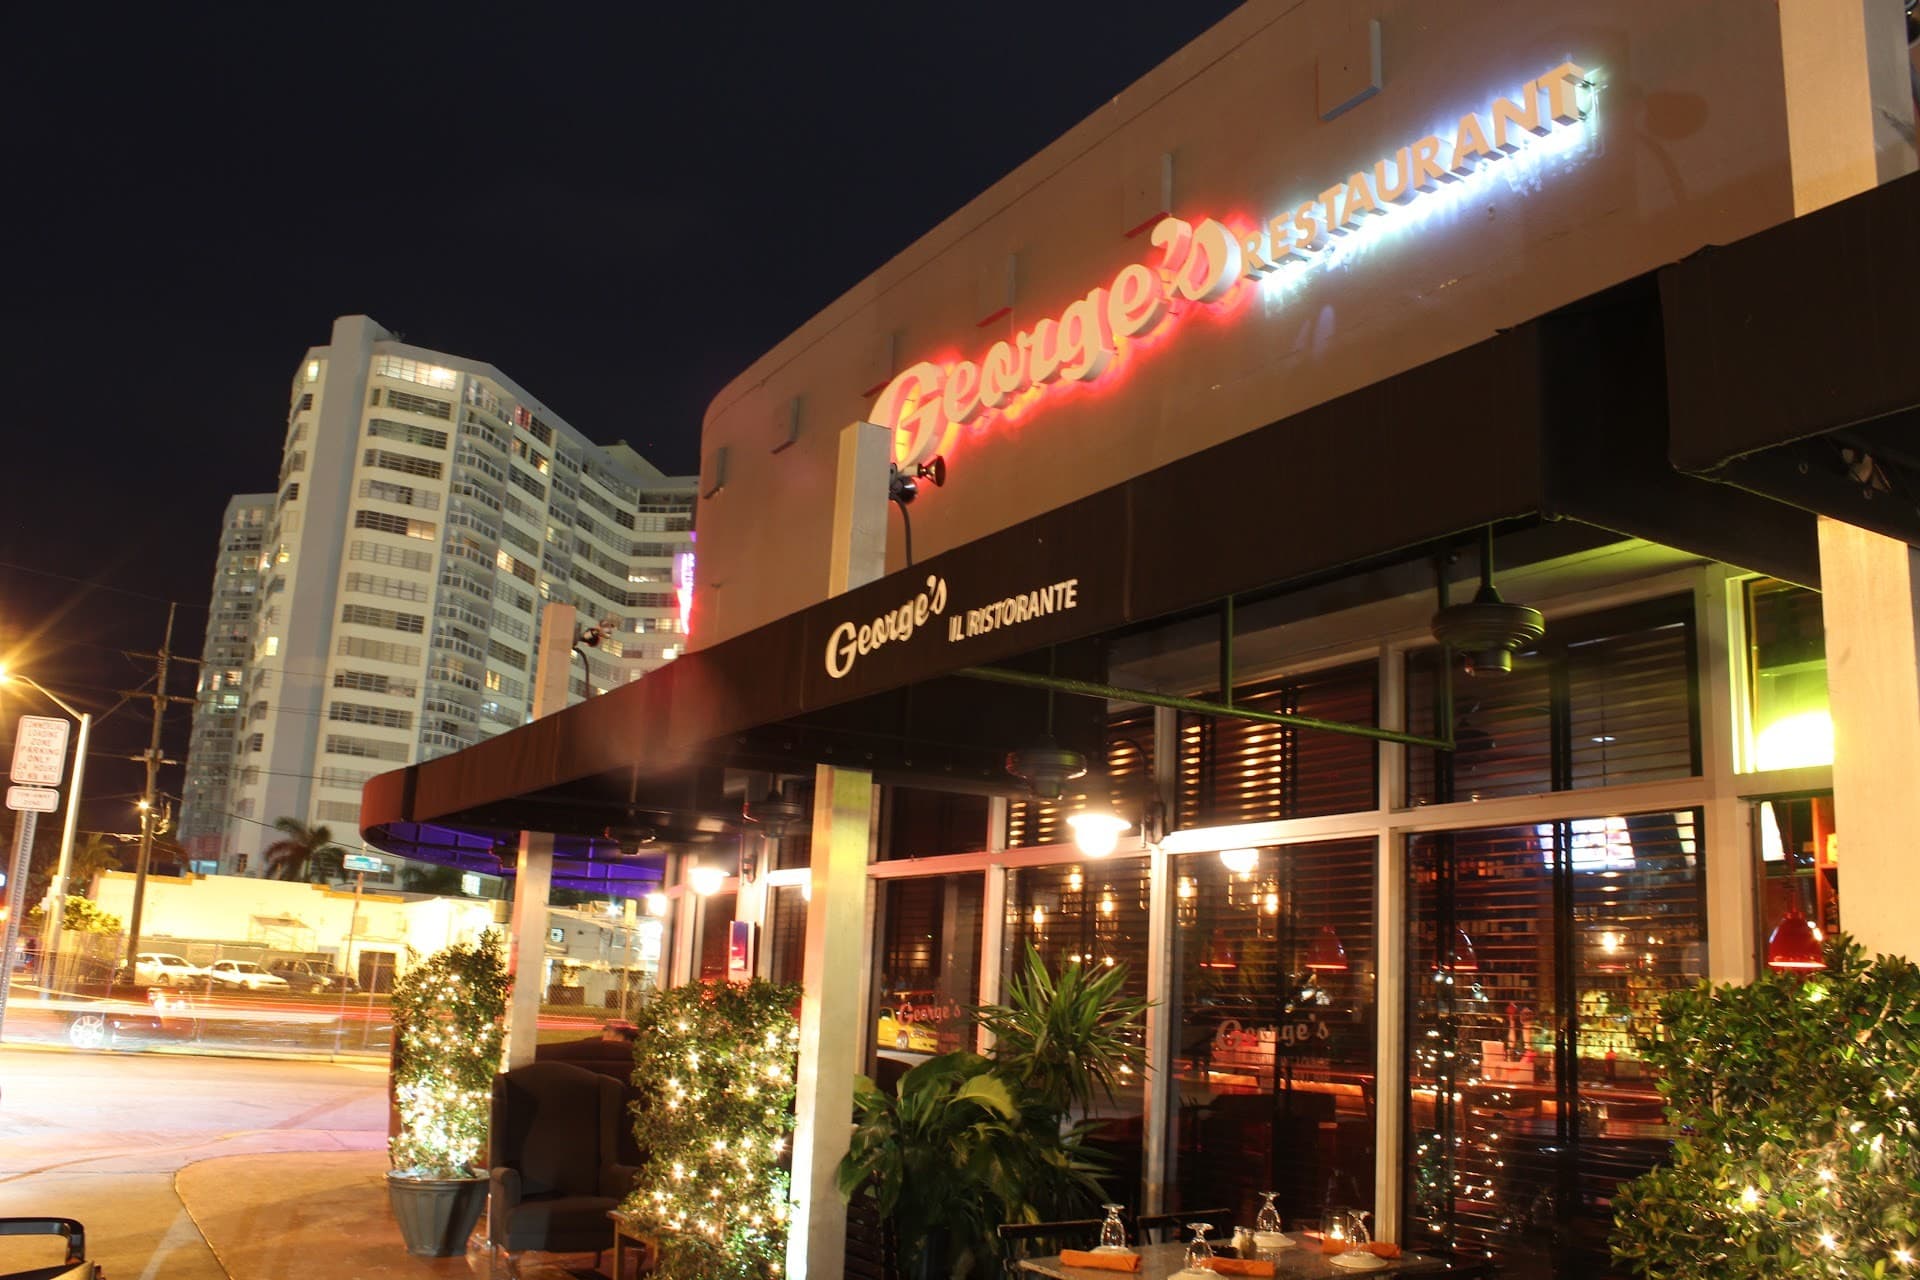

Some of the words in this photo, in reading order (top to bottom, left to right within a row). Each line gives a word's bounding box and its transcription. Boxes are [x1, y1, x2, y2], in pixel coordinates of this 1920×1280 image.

[868, 217, 1241, 470] George's
[1240, 61, 1584, 282] RESTAURANT
[825, 575, 947, 679] George's
[948, 614, 965, 642] IL
[966, 579, 1079, 637] RISTORANTE
[31, 739, 51, 747] ZONE
[20, 746, 60, 756] PARKING
[27, 755, 51, 763] ONLY
